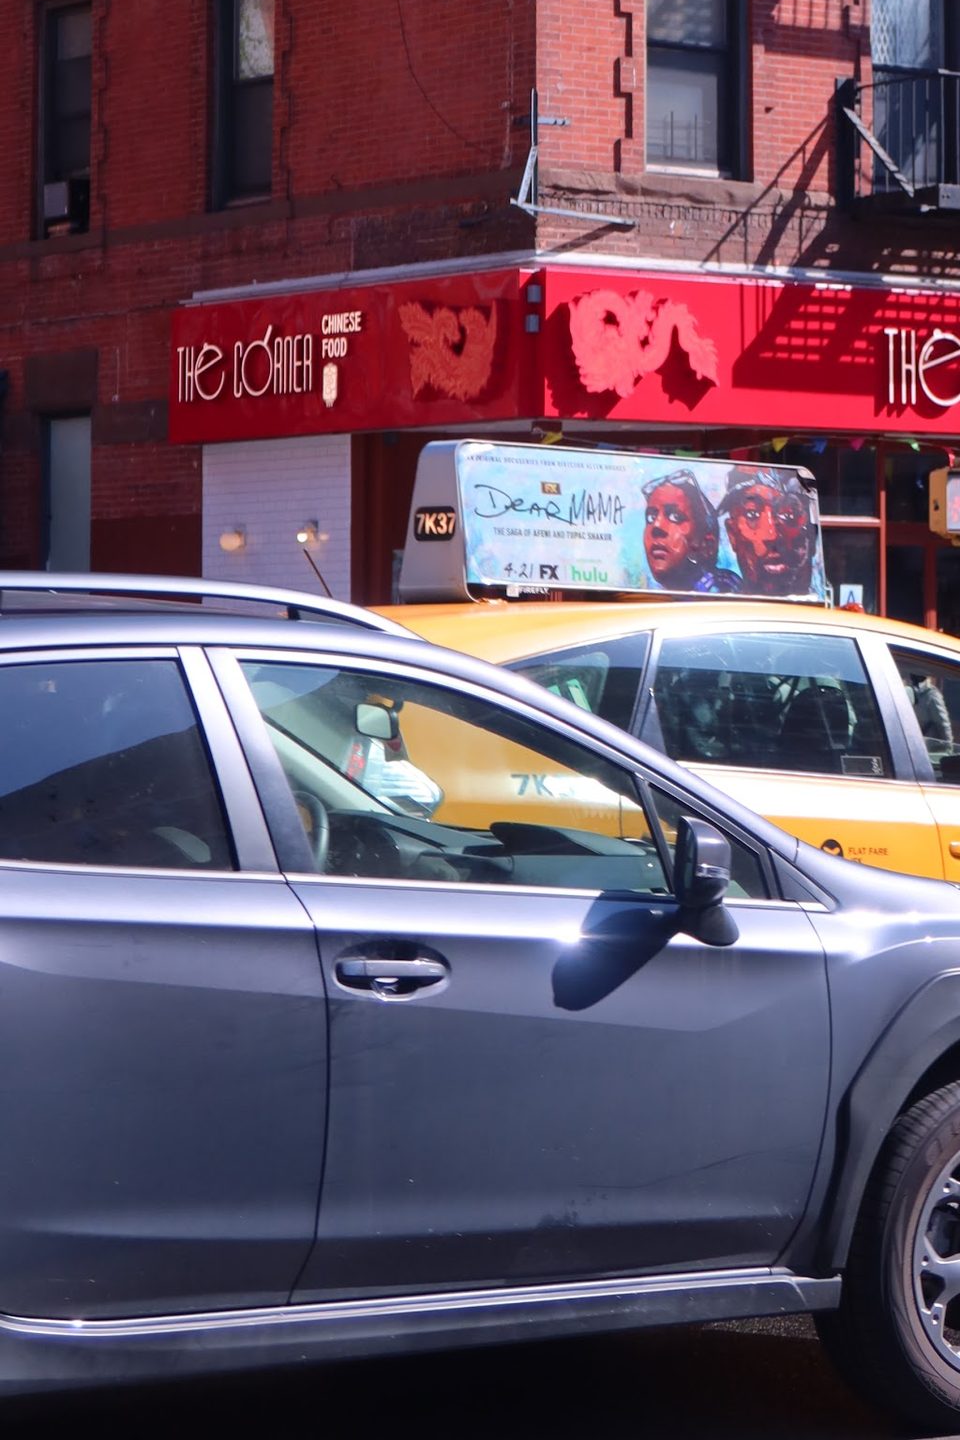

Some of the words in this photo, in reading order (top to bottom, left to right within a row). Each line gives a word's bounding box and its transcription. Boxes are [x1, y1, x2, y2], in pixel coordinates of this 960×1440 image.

[322, 311, 362, 335] CHINESE
[322, 337, 347, 358] FOOD
[233, 324, 313, 399] CORNER
[569, 489, 627, 526] MAMA
[416, 512, 456, 535] 7K37
[493, 527, 505, 536] THE
[507, 527, 522, 537] SAGA
[524, 528, 532, 537] OF
[553, 529, 566, 539] AND
[588, 531, 612, 541] SHAKUR
[539, 565, 559, 580] FX
[571, 566, 608, 582] hulu
[847, 847, 866, 856] FLAT
[868, 847, 889, 856] FARE
